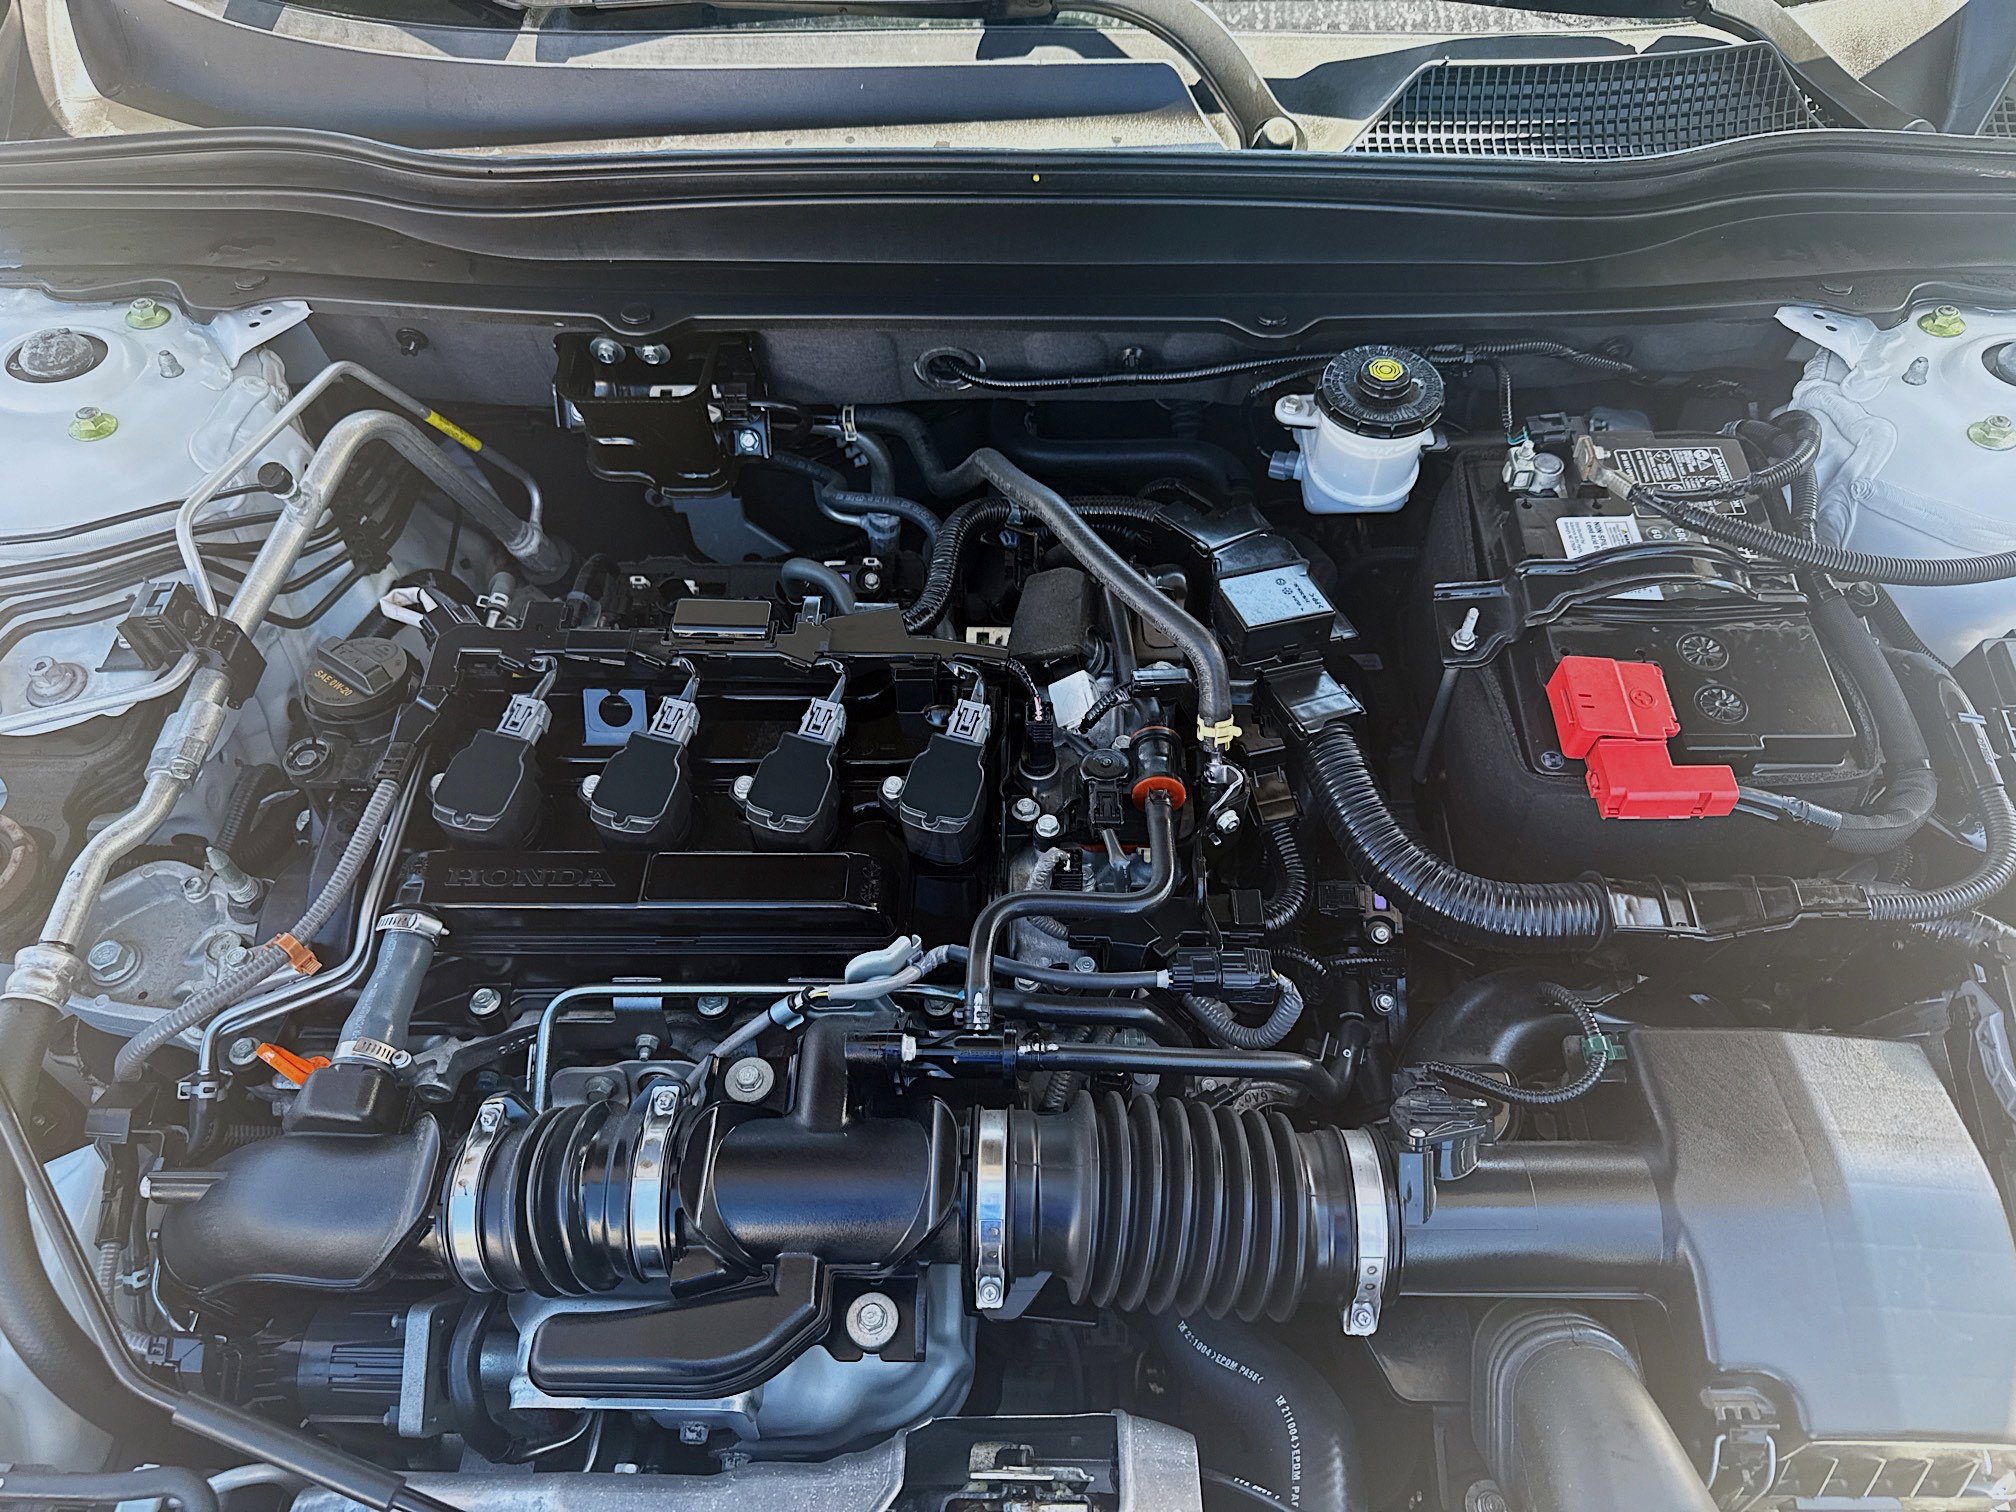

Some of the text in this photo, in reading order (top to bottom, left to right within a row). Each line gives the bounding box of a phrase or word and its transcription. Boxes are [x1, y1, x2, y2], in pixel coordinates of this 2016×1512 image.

[1651, 529, 1663, 540] 60
[314, 669, 353, 696] SAE 0W-20
[444, 867, 617, 887] HONDA
